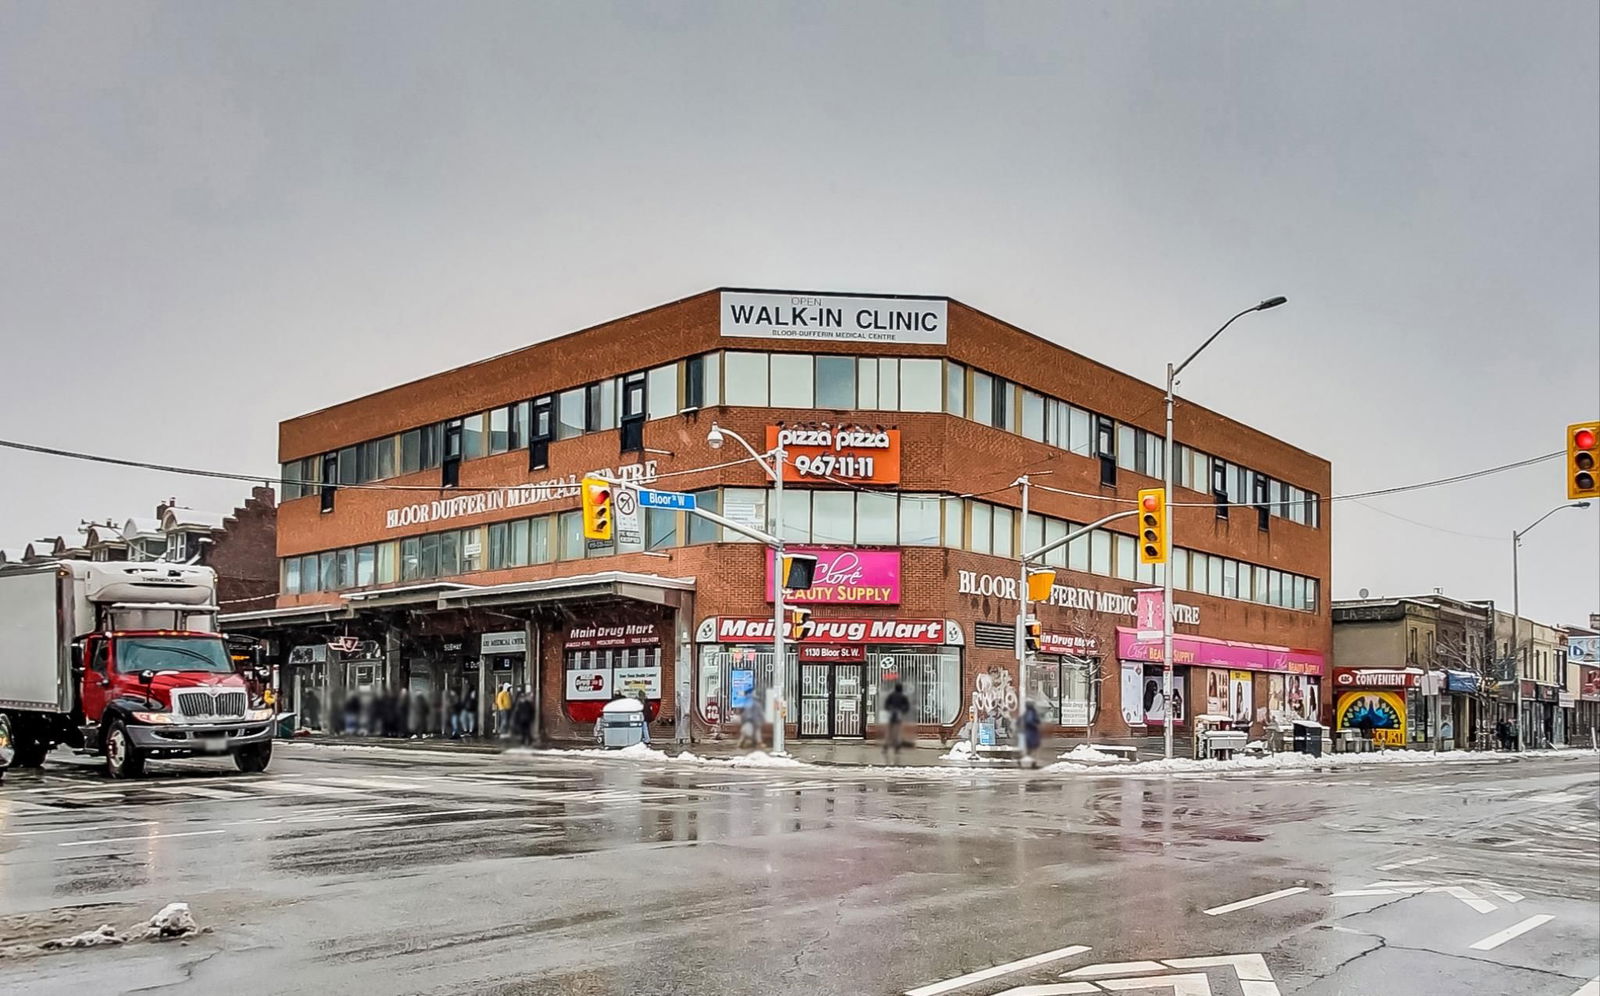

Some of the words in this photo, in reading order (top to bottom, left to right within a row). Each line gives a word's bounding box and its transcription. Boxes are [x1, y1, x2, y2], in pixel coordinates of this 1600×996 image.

[791, 297, 822, 306] OPEN
[730, 304, 842, 327] WALK-IN
[856, 310, 938, 331] CLINIC
[778, 430, 832, 450] pizza
[835, 431, 889, 451] pizza
[385, 504, 430, 528] BLOOR
[506, 474, 581, 508] MEDICAL
[649, 493, 671, 506] Bloor
[678, 496, 685, 506] W
[783, 587, 833, 600] EAUTY
[837, 586, 891, 601] SUPPLY
[958, 570, 1018, 600] BLOOR
[1018, 580, 1095, 612] DFERIN
[1096, 592, 1138, 616] MEDIC
[570, 627, 596, 639] Main
[597, 626, 625, 637] Drug
[626, 624, 654, 635] Mart
[720, 619, 792, 637] Main
[870, 622, 942, 639] Mart
[1052, 634, 1073, 647] Drug
[804, 648, 820, 656] 1130
[821, 648, 840, 657] Bloor
[1356, 673, 1406, 686] CONVENIENT
